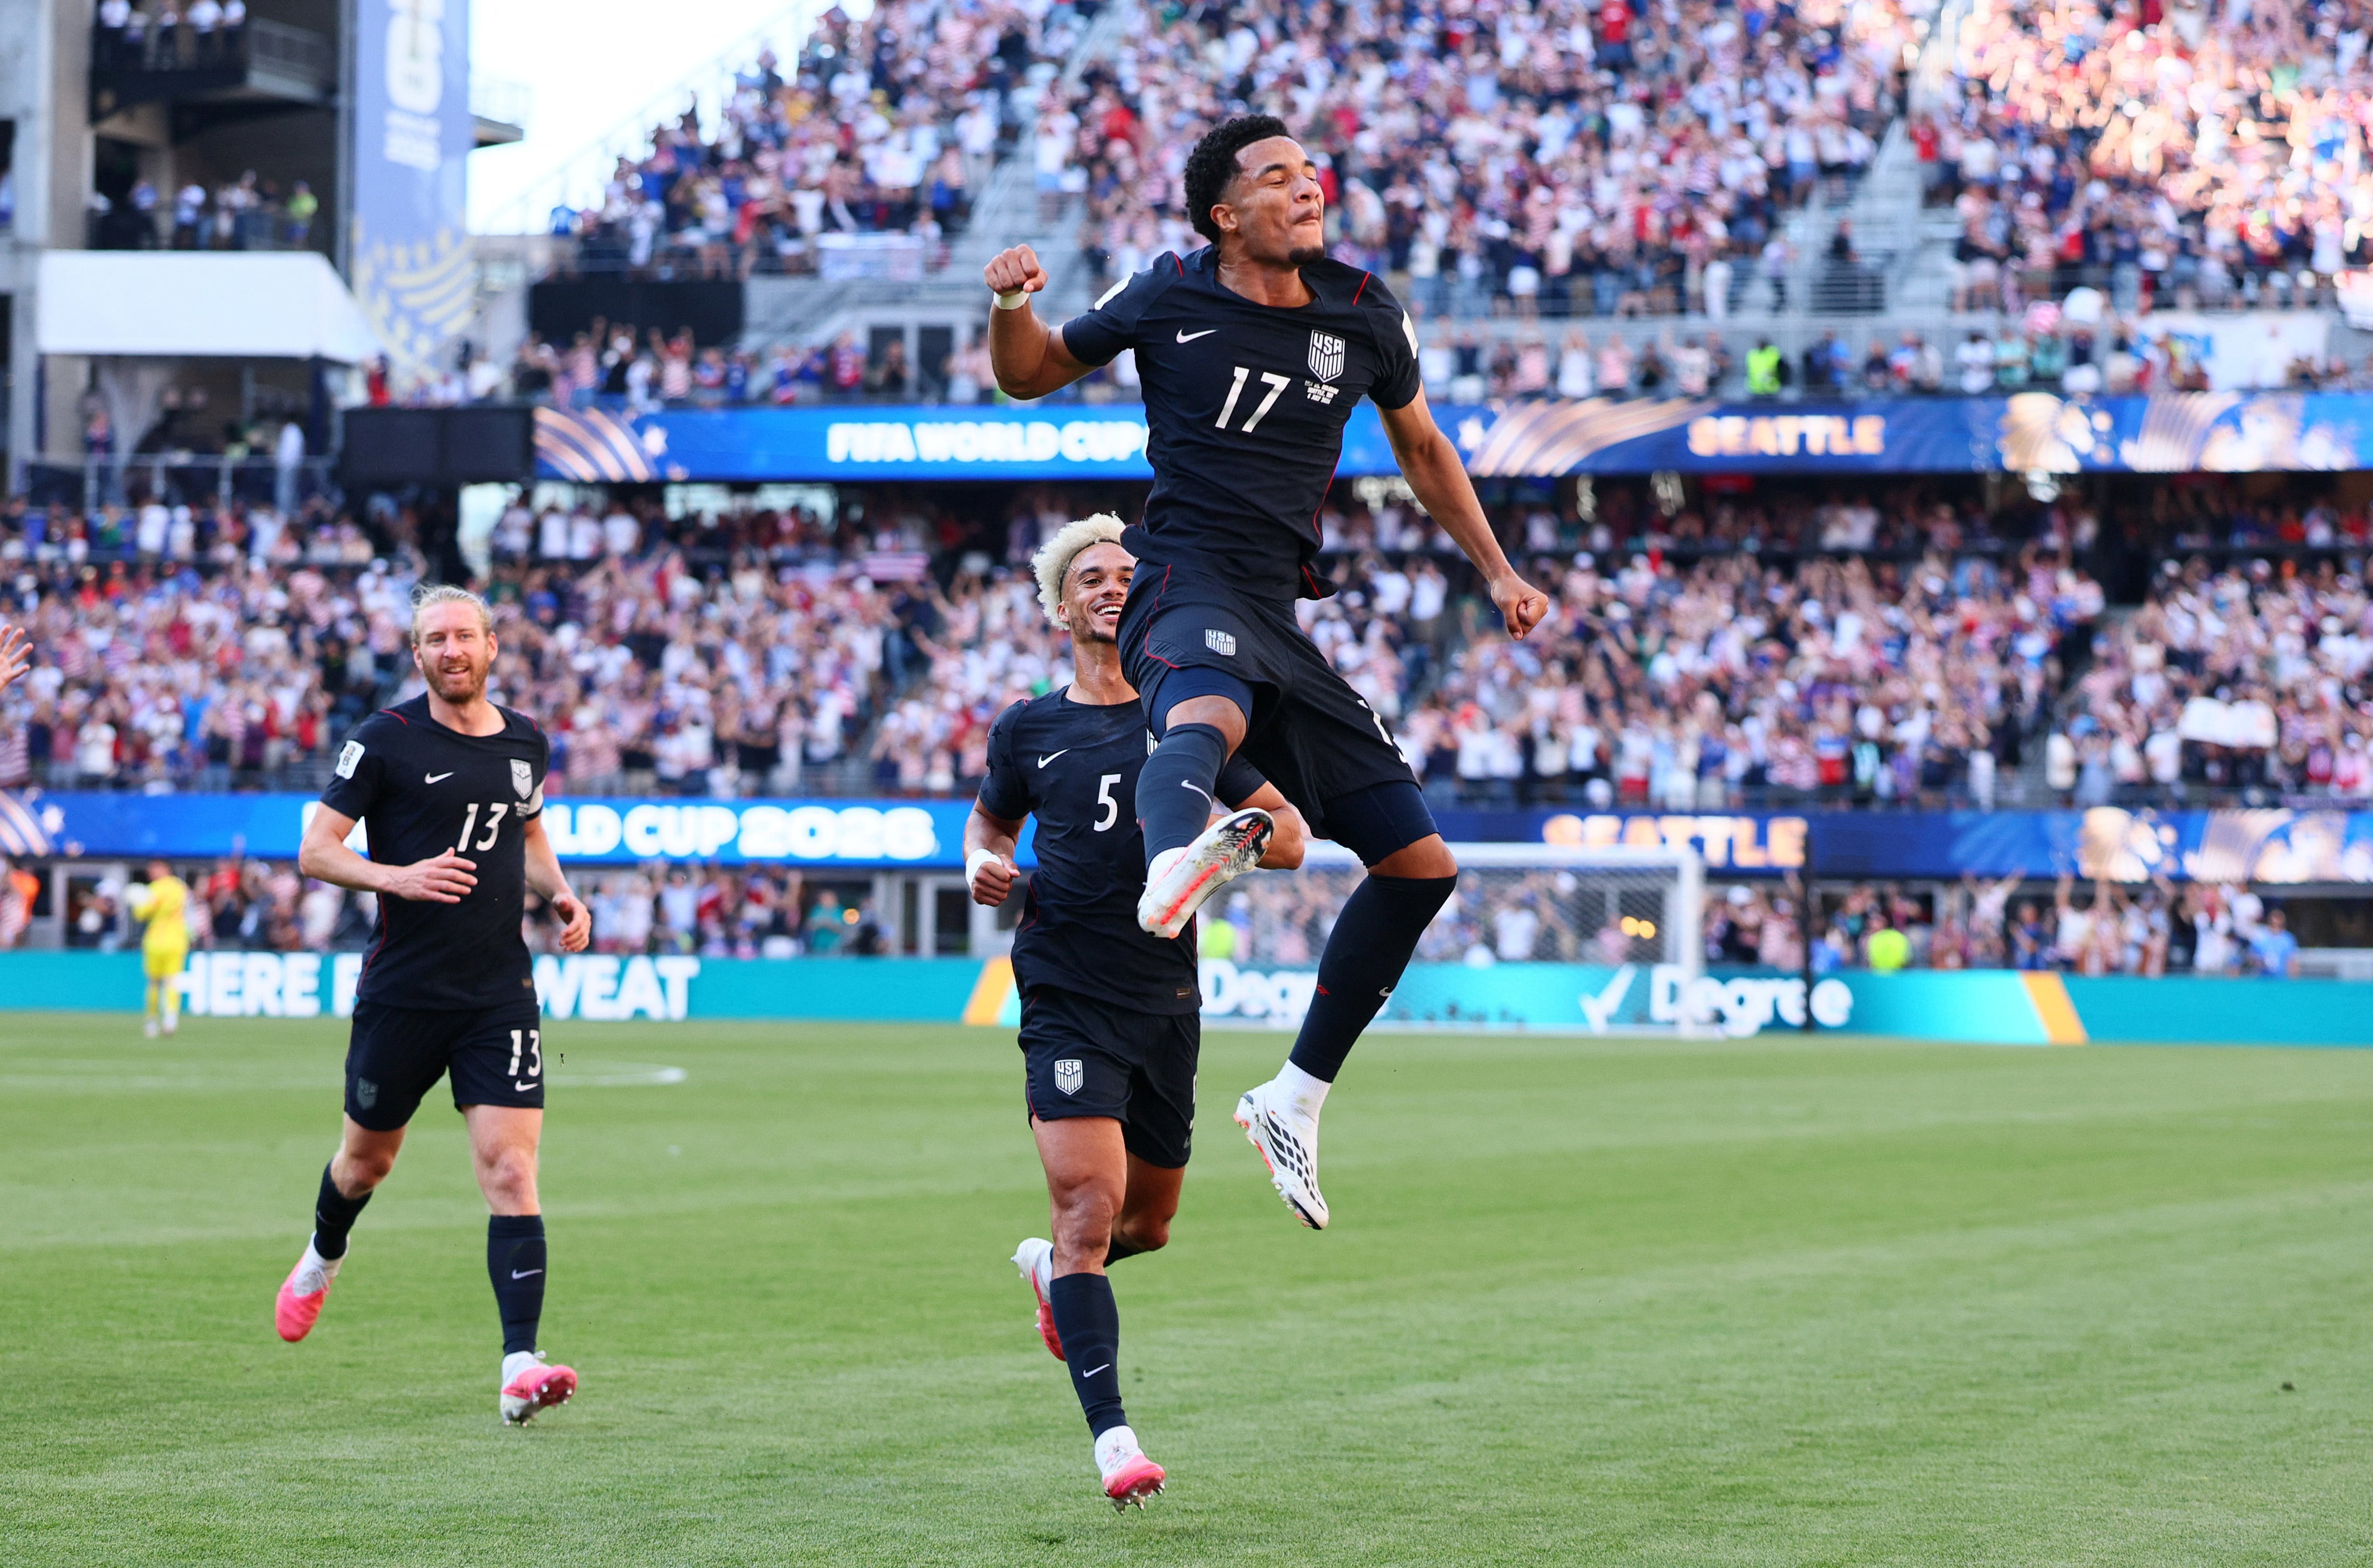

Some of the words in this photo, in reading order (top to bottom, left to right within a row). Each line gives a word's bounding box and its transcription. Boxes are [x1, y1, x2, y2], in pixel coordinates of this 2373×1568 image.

[1313, 332, 1343, 355] USA
[1215, 366, 1291, 432] 17
[828, 422, 917, 463] FIFA
[915, 421, 1060, 463] WORLD
[1058, 420, 1145, 463] CUP
[1687, 415, 1885, 456] SEATTLE
[1208, 630, 1233, 643] USA
[457, 803, 508, 852] 13
[1093, 774, 1121, 832] 5
[624, 805, 738, 857] CUP
[737, 806, 936, 860] 2026
[1542, 814, 1808, 868] SEATTLE
[177, 950, 322, 1016] HERE
[532, 954, 701, 1022] WEAT
[1649, 963, 1854, 1037] Degree
[508, 1029, 542, 1077] 13
[1057, 1062, 1080, 1076] USA
